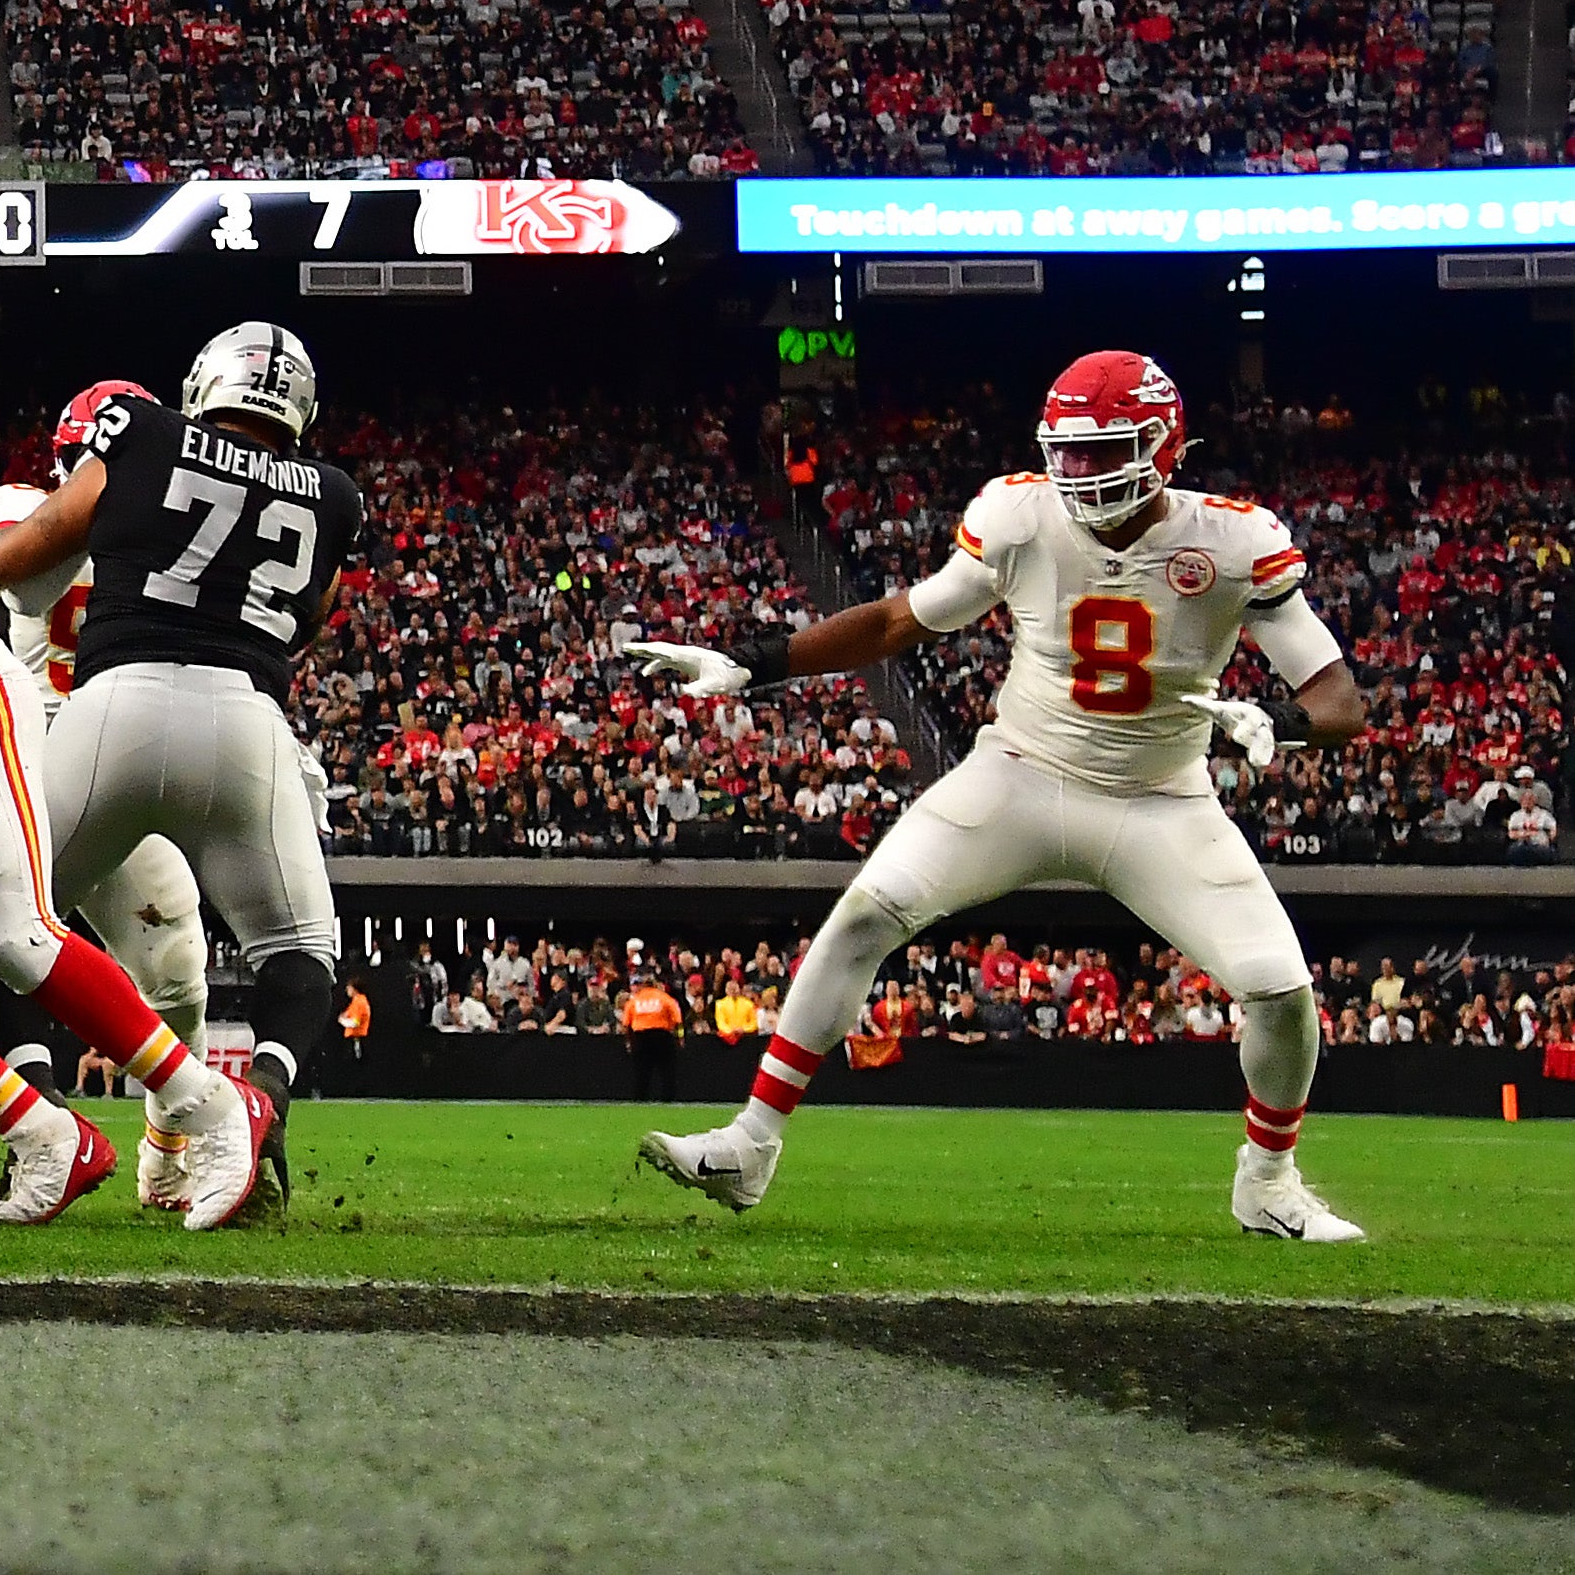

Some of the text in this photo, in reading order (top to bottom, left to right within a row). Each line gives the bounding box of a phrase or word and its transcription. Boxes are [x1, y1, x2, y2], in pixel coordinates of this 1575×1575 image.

[310, 190, 351, 249] 7
[1031, 205, 1074, 236] at
[241, 395, 287, 416] RAIDERS
[142, 466, 318, 645] 72
[1069, 596, 1155, 715] 8
[526, 827, 564, 848] 102
[1284, 834, 1321, 855] 103
